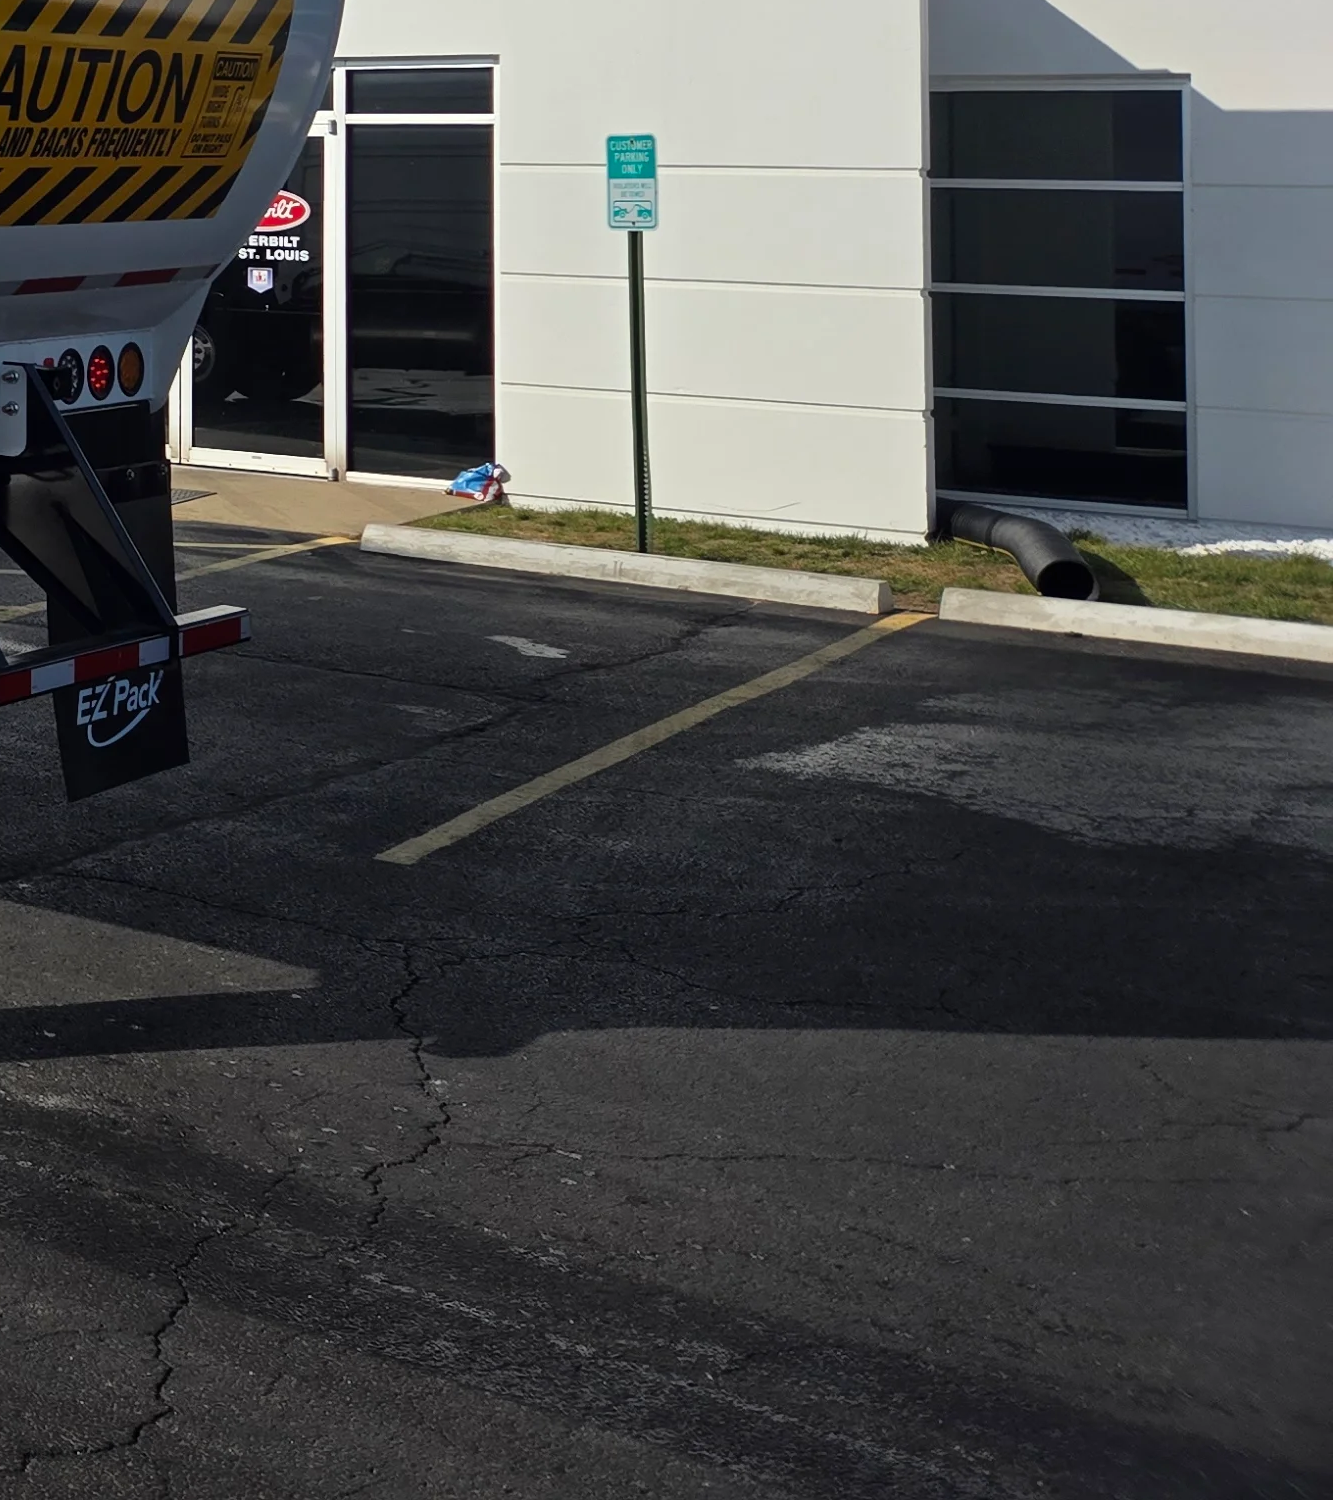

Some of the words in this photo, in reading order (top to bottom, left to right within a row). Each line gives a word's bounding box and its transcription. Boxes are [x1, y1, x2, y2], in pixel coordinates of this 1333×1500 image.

[215, 61, 256, 78] CAUTION
[33, 127, 88, 158] BACKS
[86, 128, 182, 160] FREQUENTLY
[610, 140, 653, 151] CUSTOMER
[614, 152, 649, 162] PARKING
[621, 164, 643, 174] ONLY
[243, 235, 300, 247] ERBILT
[238, 248, 260, 260] ST.
[266, 249, 309, 261] LOUIS
[113, 670, 162, 715] Pack
